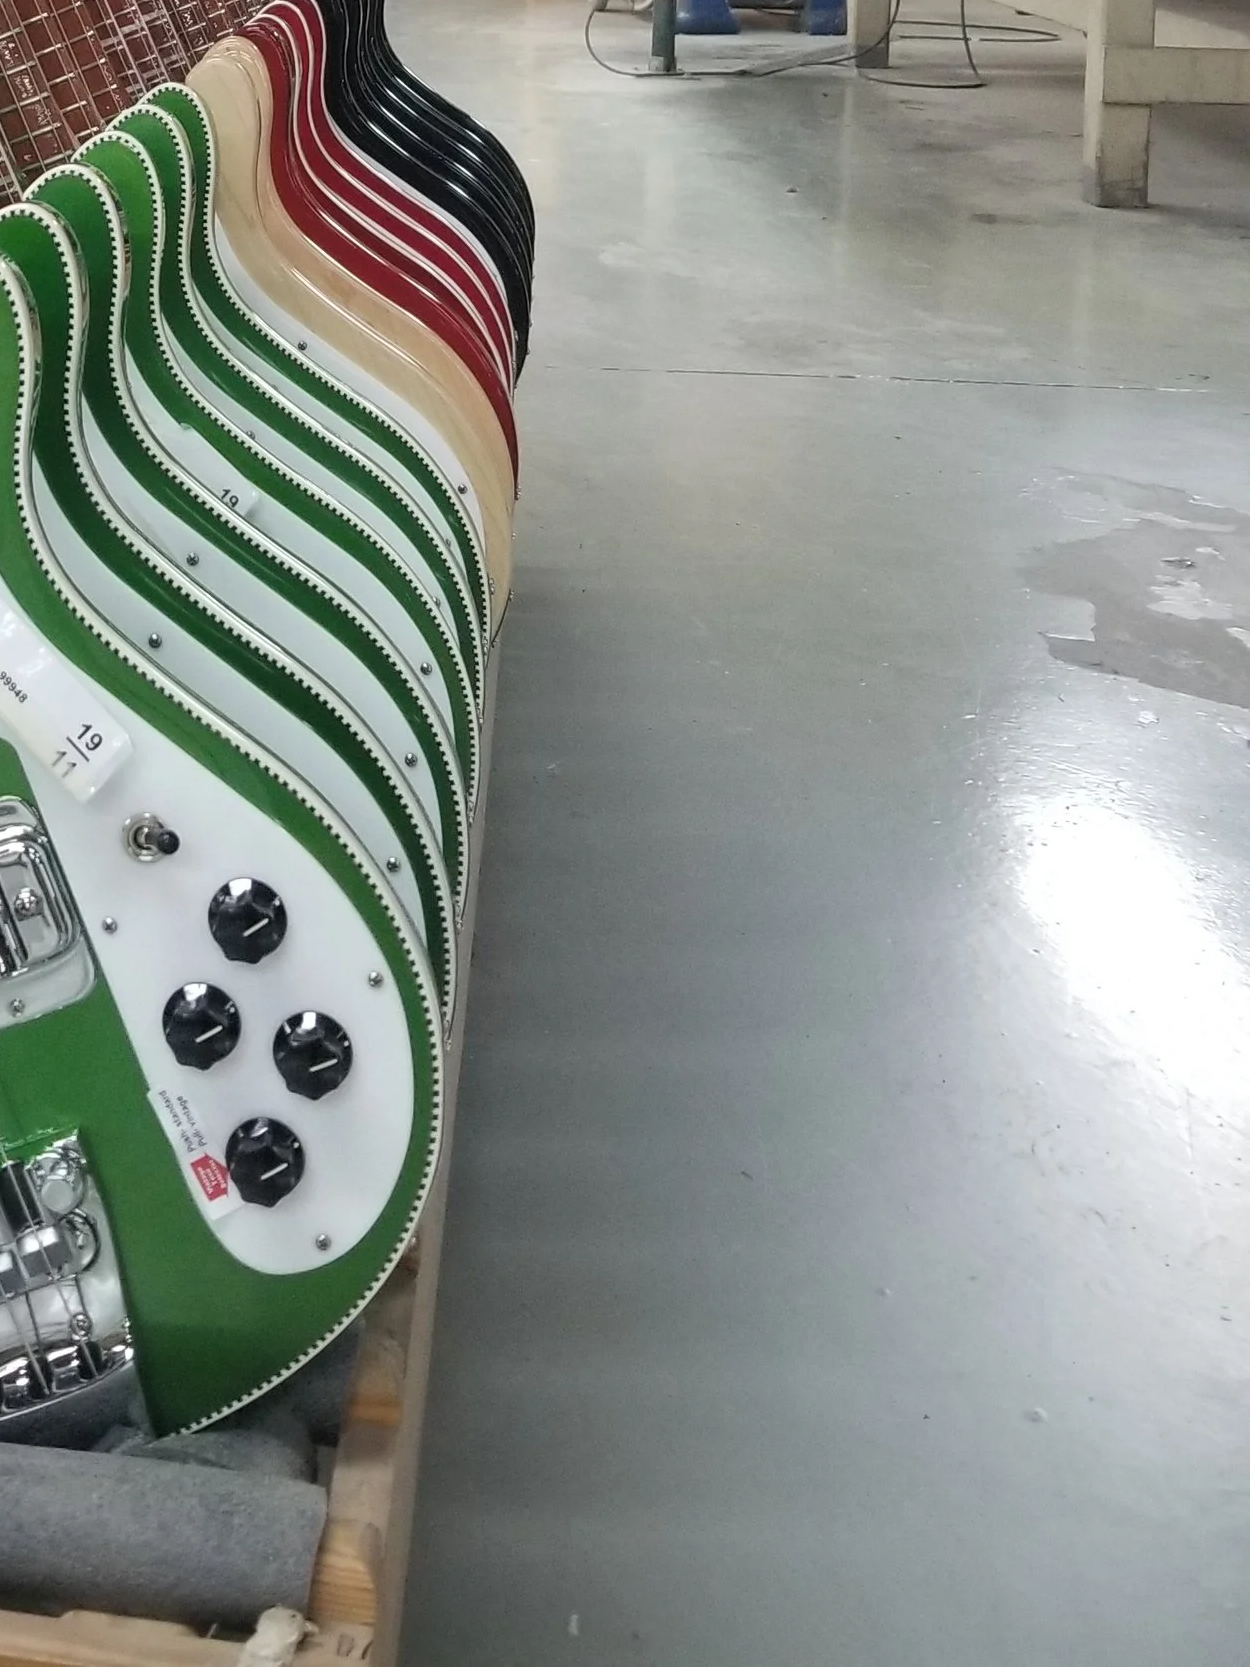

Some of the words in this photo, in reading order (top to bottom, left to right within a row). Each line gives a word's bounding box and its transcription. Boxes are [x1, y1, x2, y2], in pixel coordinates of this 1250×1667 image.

[222, 488, 240, 508] 19
[77, 723, 103, 752] 19
[52, 750, 77, 778] 11
